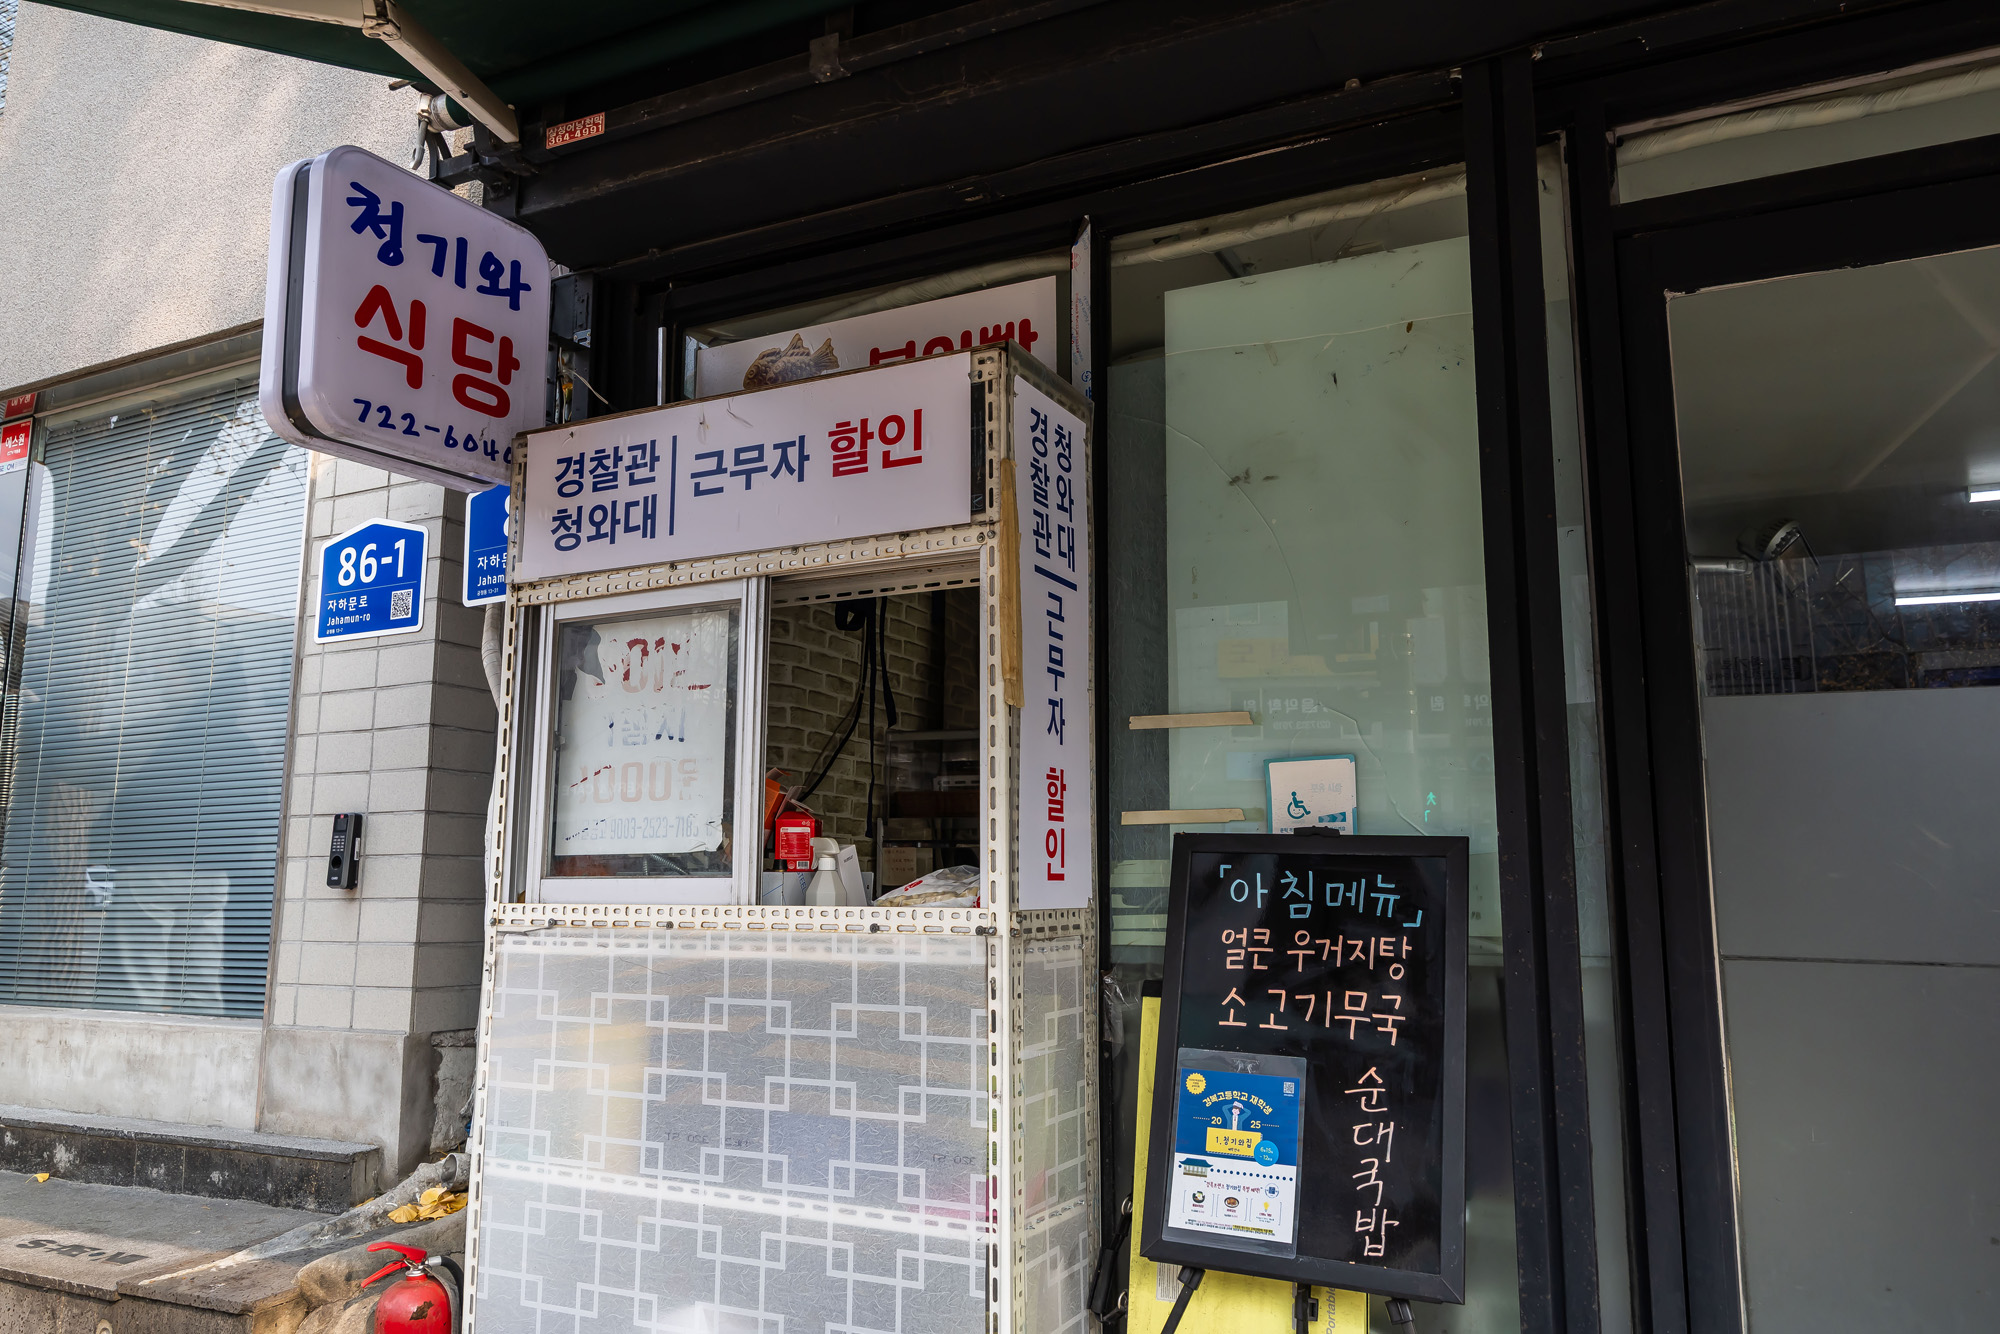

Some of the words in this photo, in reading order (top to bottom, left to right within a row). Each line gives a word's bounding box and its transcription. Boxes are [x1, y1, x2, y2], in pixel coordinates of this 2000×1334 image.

[549, 125, 602, 145] 364-4991
[345, 181, 531, 311] 청기와
[354, 284, 519, 418] 식당
[5, 433, 25, 448] 에스원
[555, 439, 660, 499] 경찰관
[690, 434, 810, 497] 근무자
[828, 408, 923, 478] 할인
[1030, 407, 1052, 559] 경찰관
[1054, 423, 1076, 573] 청와대
[551, 493, 658, 552] 청와대
[337, 538, 406, 587] 86-1
[326, 613, 371, 627] Jahamun-ro
[327, 595, 368, 612] 자하문로
[1045, 590, 1067, 746] 근무자
[1045, 767, 1067, 881] 할인
[1221, 928, 1274, 970] 얼큰
[1287, 930, 1413, 980] 우거지탕
[1202, 1090, 1249, 1107] 경복고등학교
[1250, 1094, 1273, 1115] 재학생
[1211, 1116, 1222, 1125] 20
[1250, 1120, 1261, 1129] 25
[1344, 1066, 1400, 1257] 순대국밥
[1326, 1286, 1336, 1334] Portable
